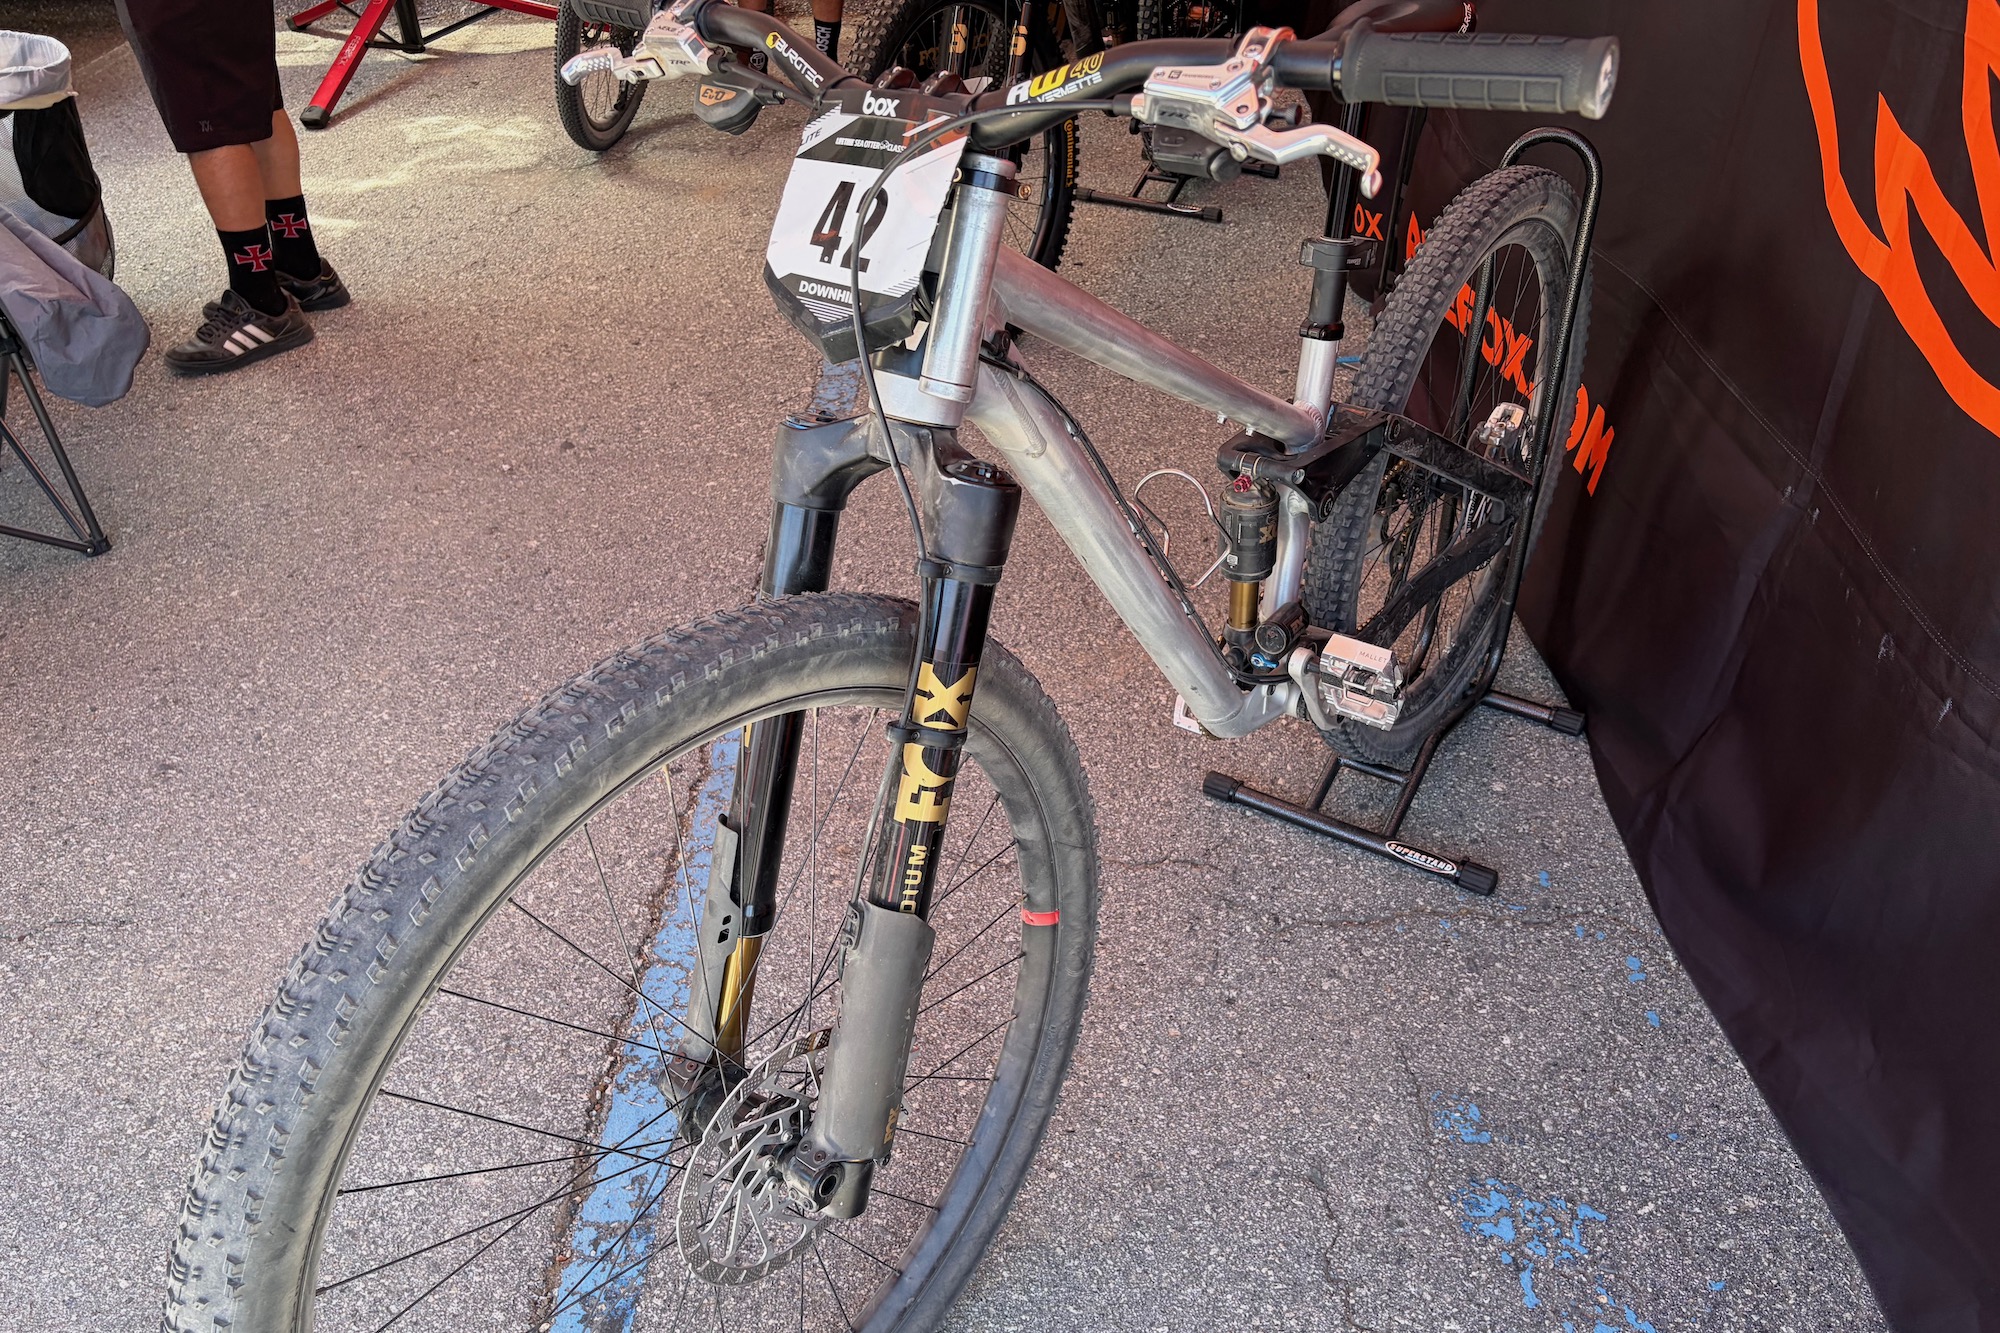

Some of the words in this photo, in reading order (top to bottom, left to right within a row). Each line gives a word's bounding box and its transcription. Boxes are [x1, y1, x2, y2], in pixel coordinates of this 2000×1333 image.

[816, 25, 832, 55] OSCH
[774, 38, 824, 89] BURGTEC
[1070, 51, 1105, 79] 40
[1036, 71, 1103, 103] VERMETTE
[862, 90, 901, 118] box
[804, 127, 822, 145] ITE
[854, 139, 864, 148] SEA
[864, 140, 881, 151] OTTER
[887, 143, 907, 154] CLASS
[1063, 119, 1074, 179] Continental
[809, 180, 889, 274] 42
[1353, 202, 1384, 242] OX
[798, 280, 857, 304] DOWNHIL
[1359, 650, 1388, 664] MALLET
[893, 660, 979, 827] FOX
[1389, 843, 1454, 872] SUPERSTAND
[899, 844, 928, 915] DIUM
